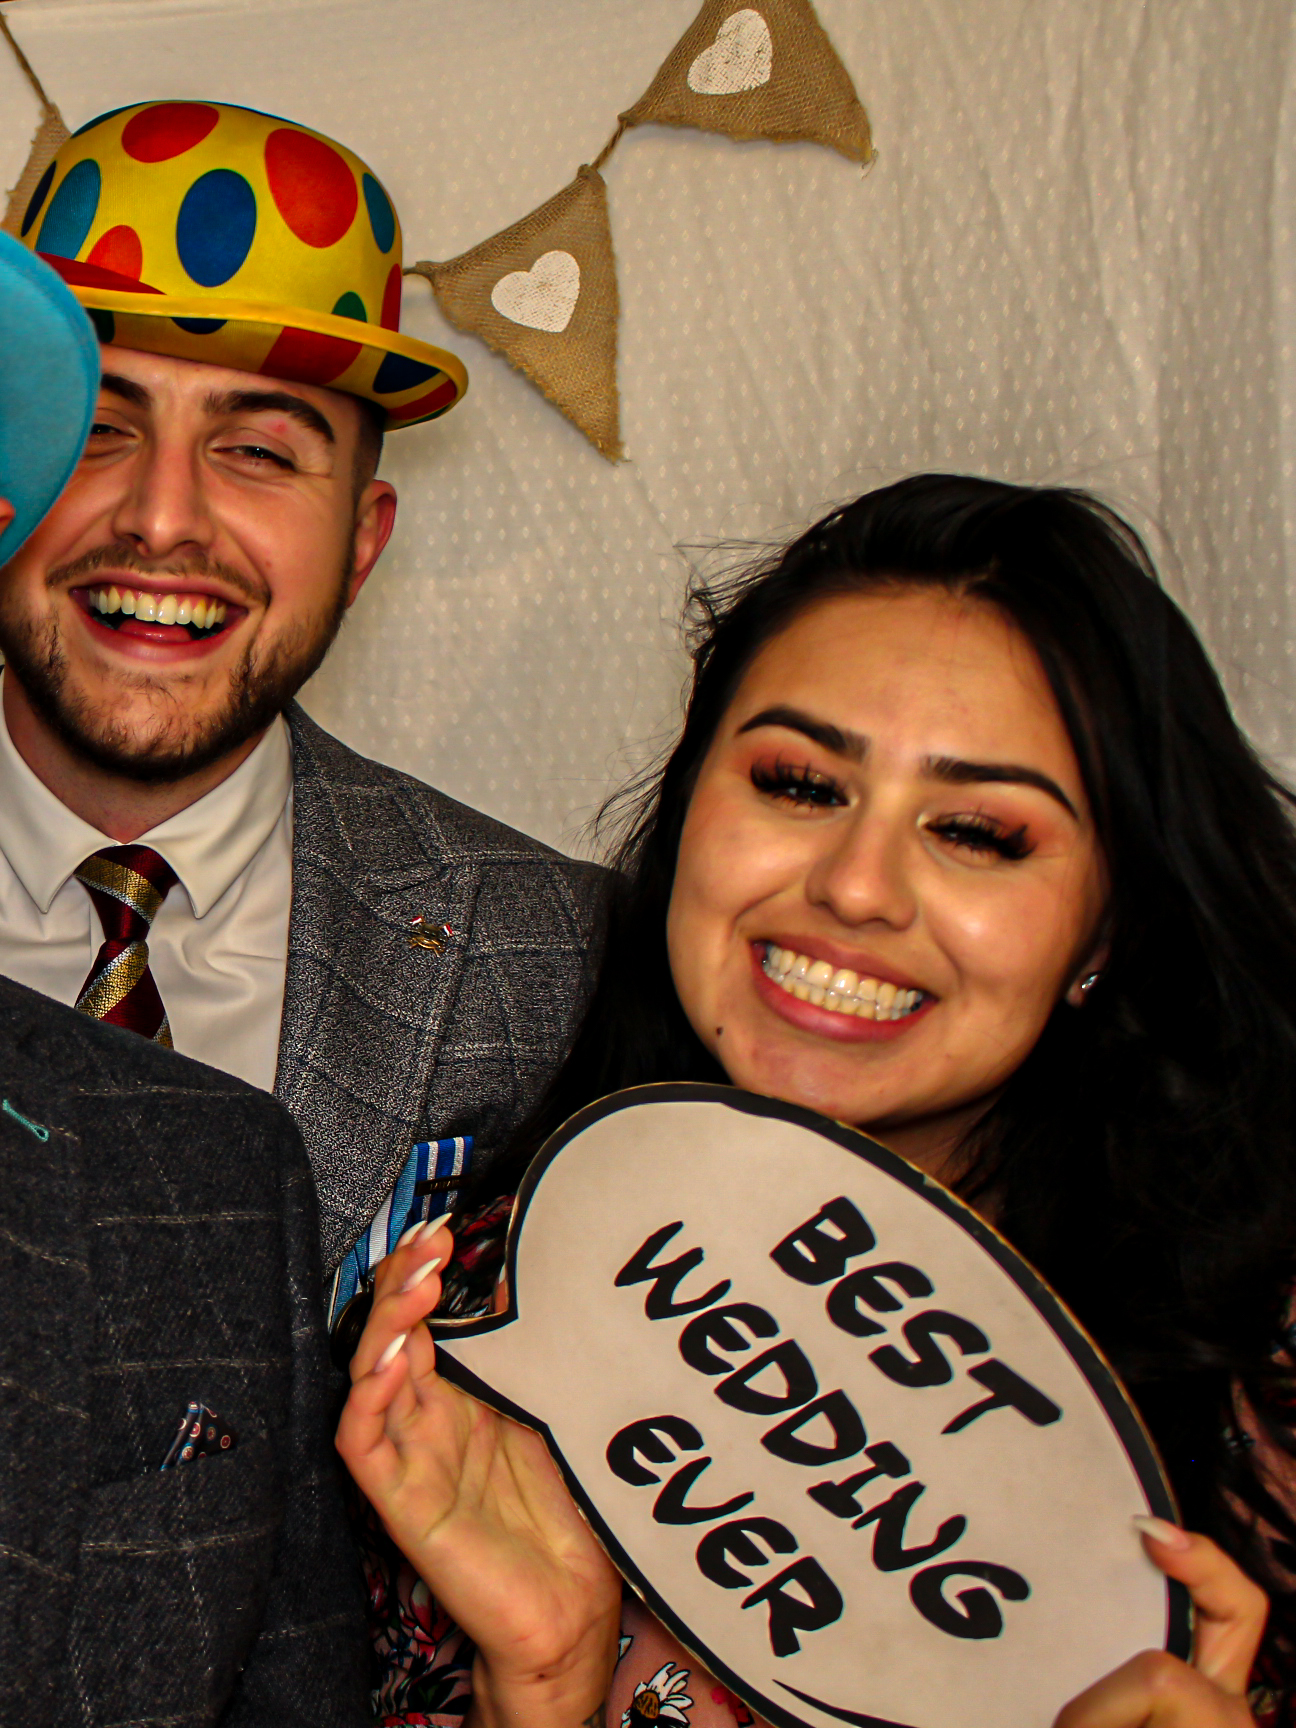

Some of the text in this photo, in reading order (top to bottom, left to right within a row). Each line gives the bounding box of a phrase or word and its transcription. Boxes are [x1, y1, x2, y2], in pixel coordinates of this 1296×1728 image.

[614, 1221, 1031, 1640] WEDDING
[770, 1197, 1063, 1435] BEST
[606, 1415, 844, 1658] EVER
